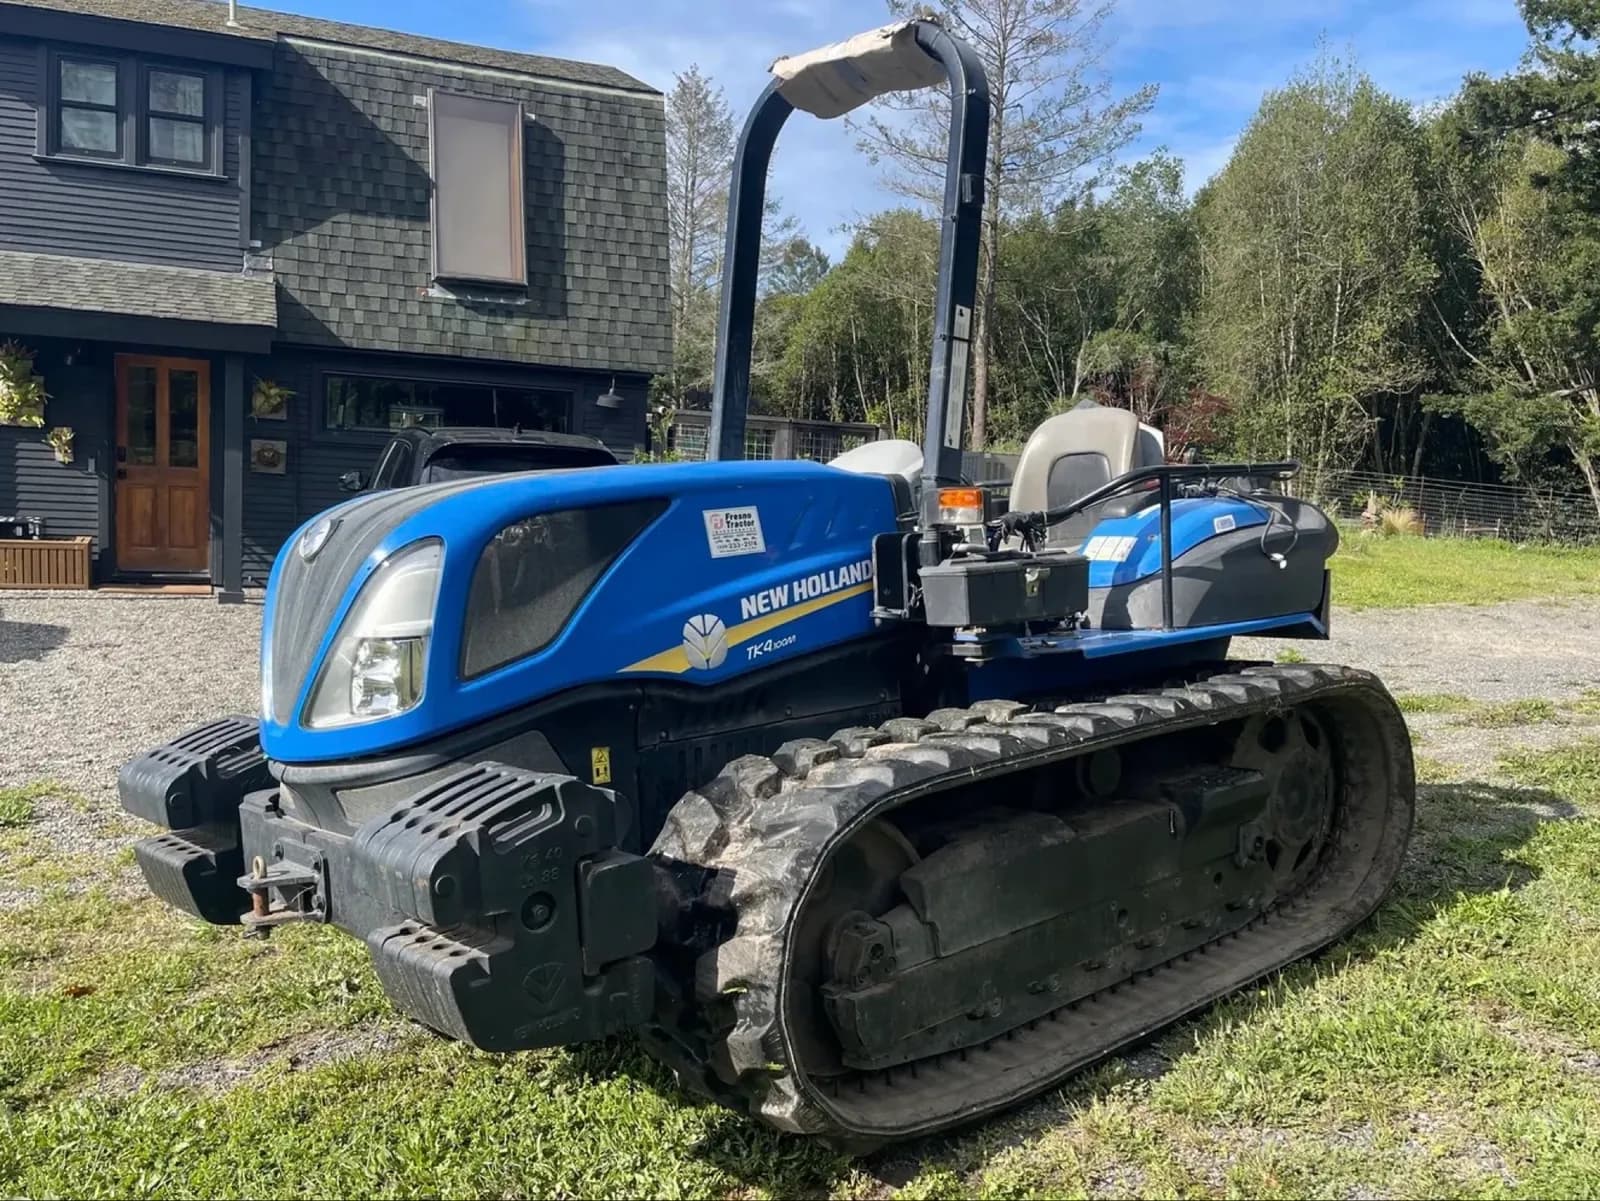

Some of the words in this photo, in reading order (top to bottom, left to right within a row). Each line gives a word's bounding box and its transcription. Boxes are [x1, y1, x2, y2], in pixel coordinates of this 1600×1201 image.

[725, 512, 752, 521] Fresno
[726, 520, 755, 528] Tractor
[740, 584, 789, 620] NEW
[793, 559, 873, 602] HOLLAND
